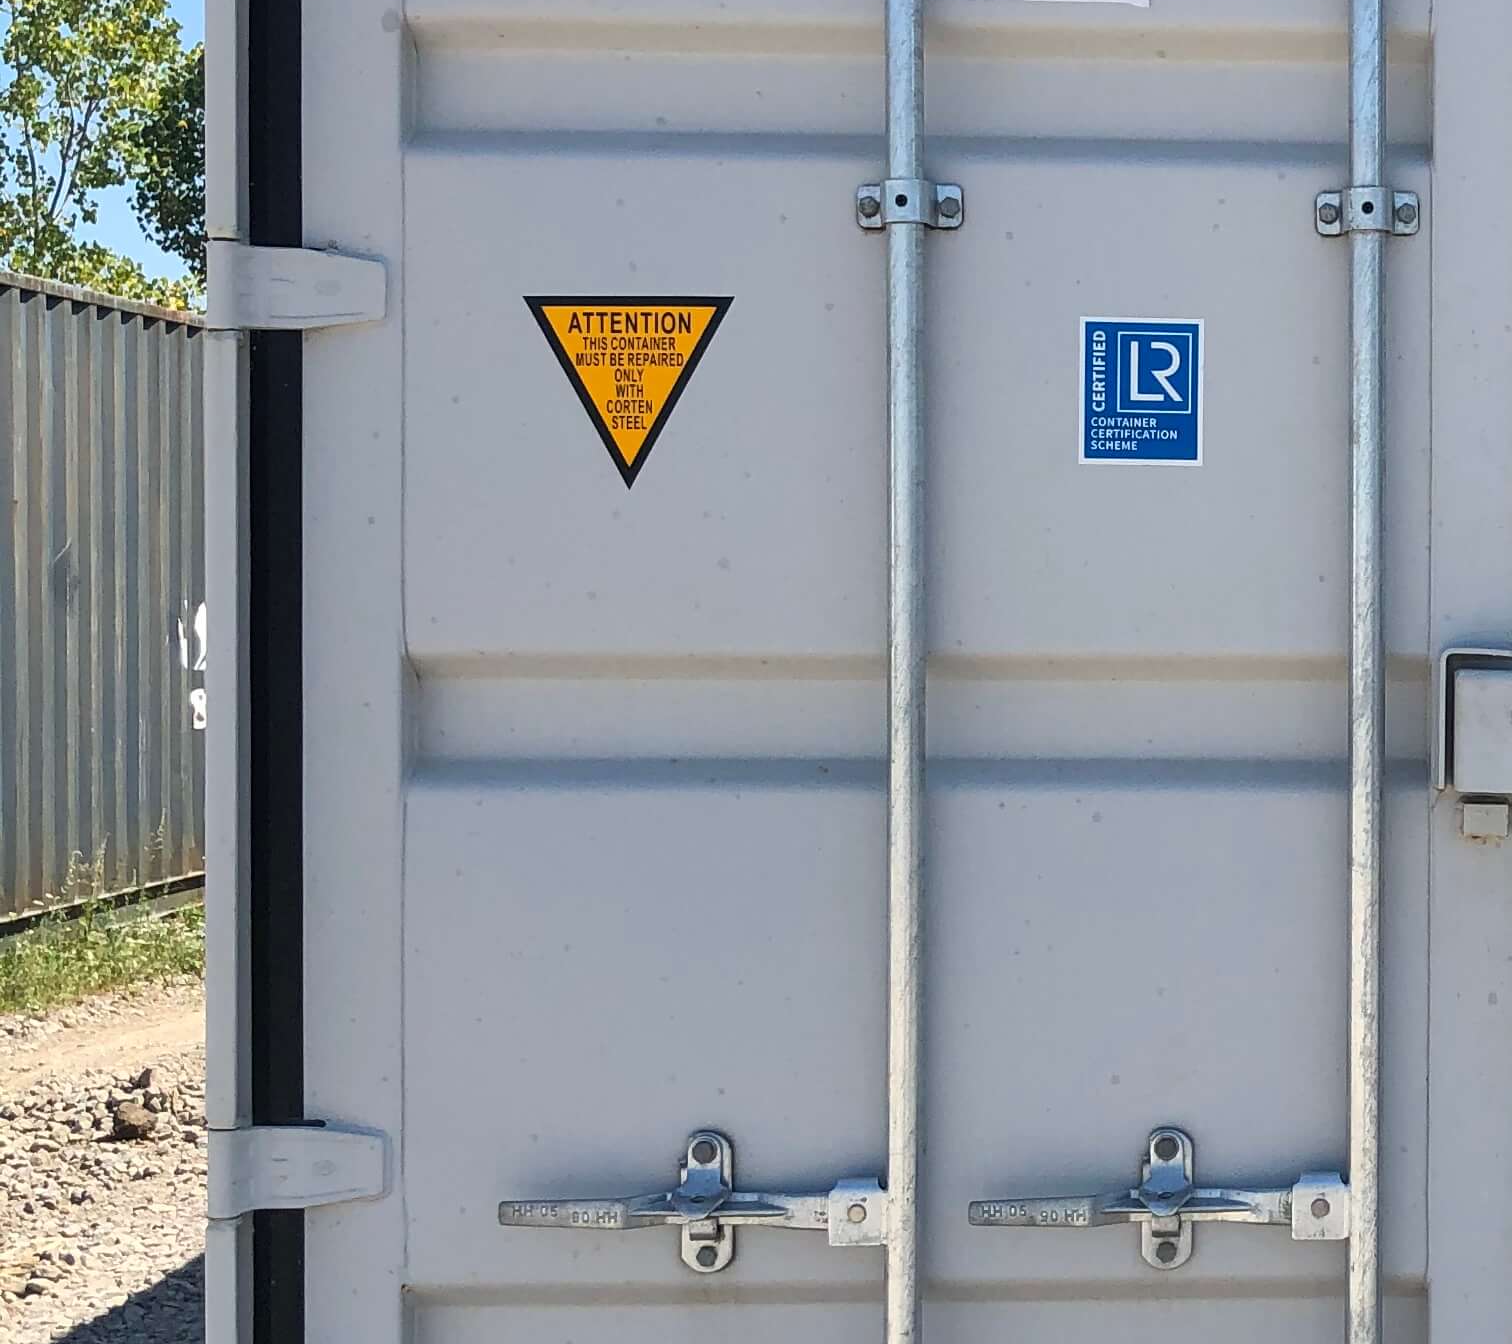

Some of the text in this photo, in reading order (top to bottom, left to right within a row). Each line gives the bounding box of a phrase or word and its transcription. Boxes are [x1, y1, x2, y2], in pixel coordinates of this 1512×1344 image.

[568, 312, 692, 334] ATTENTION
[583, 337, 676, 351] THIS CONTAINER
[576, 353, 683, 366] MUST BE REPAIRED
[615, 369, 644, 382] ONLY
[1092, 330, 1106, 412] CERTIFIED
[1130, 341, 1183, 401] LR
[615, 384, 643, 398] WITH
[606, 400, 652, 414] CORTEN
[612, 416, 647, 429] STEEL
[1091, 417, 1157, 428] CONTAINER
[1091, 428, 1177, 440] CERTIFICATION
[1091, 440, 1137, 450] SCHEME
